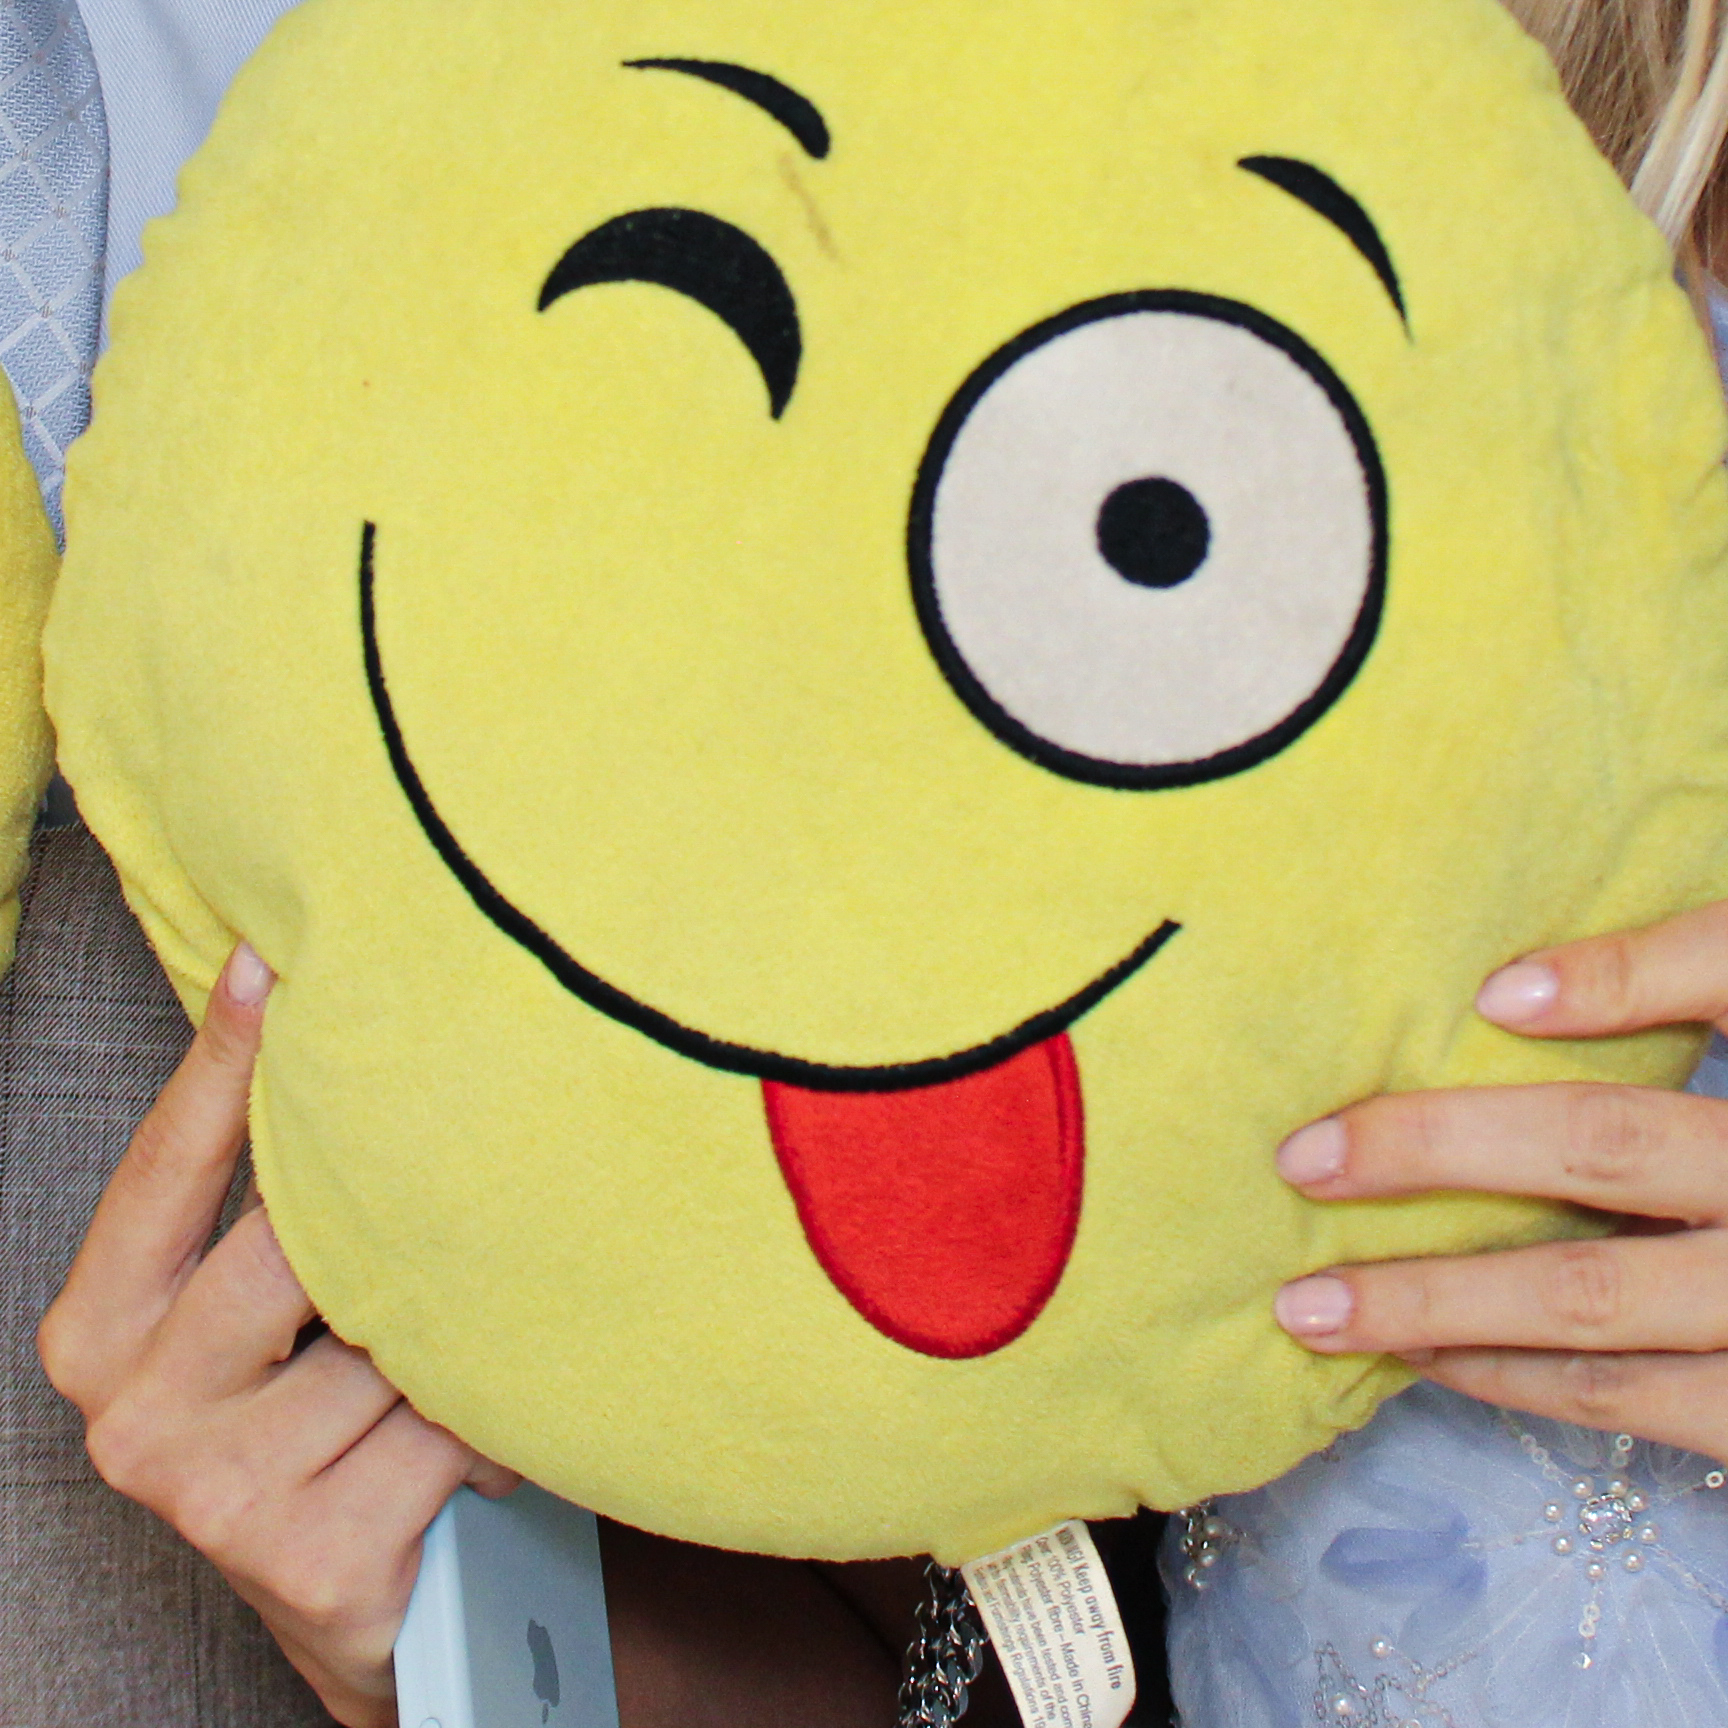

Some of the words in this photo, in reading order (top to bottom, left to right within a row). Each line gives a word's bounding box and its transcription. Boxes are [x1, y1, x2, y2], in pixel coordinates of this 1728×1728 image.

[1047, 1605, 1063, 1632] fibre
[1057, 1581, 1085, 1634] Polyester
[1073, 1562, 1093, 1593] Keep
[1085, 1596, 1105, 1629] away
[1097, 1630, 1115, 1664] from
[1107, 1664, 1124, 1690] fire
[1031, 1621, 1047, 1647] been
[1041, 1648, 1061, 1681] tested
[1053, 1683, 1068, 1704] and
[1060, 1642, 1079, 1677] Made
[1040, 1690, 1054, 1700] of
[1072, 1679, 1084, 1692] in
[1045, 1702, 1056, 1720] the
[1076, 1694, 1093, 1728] China
